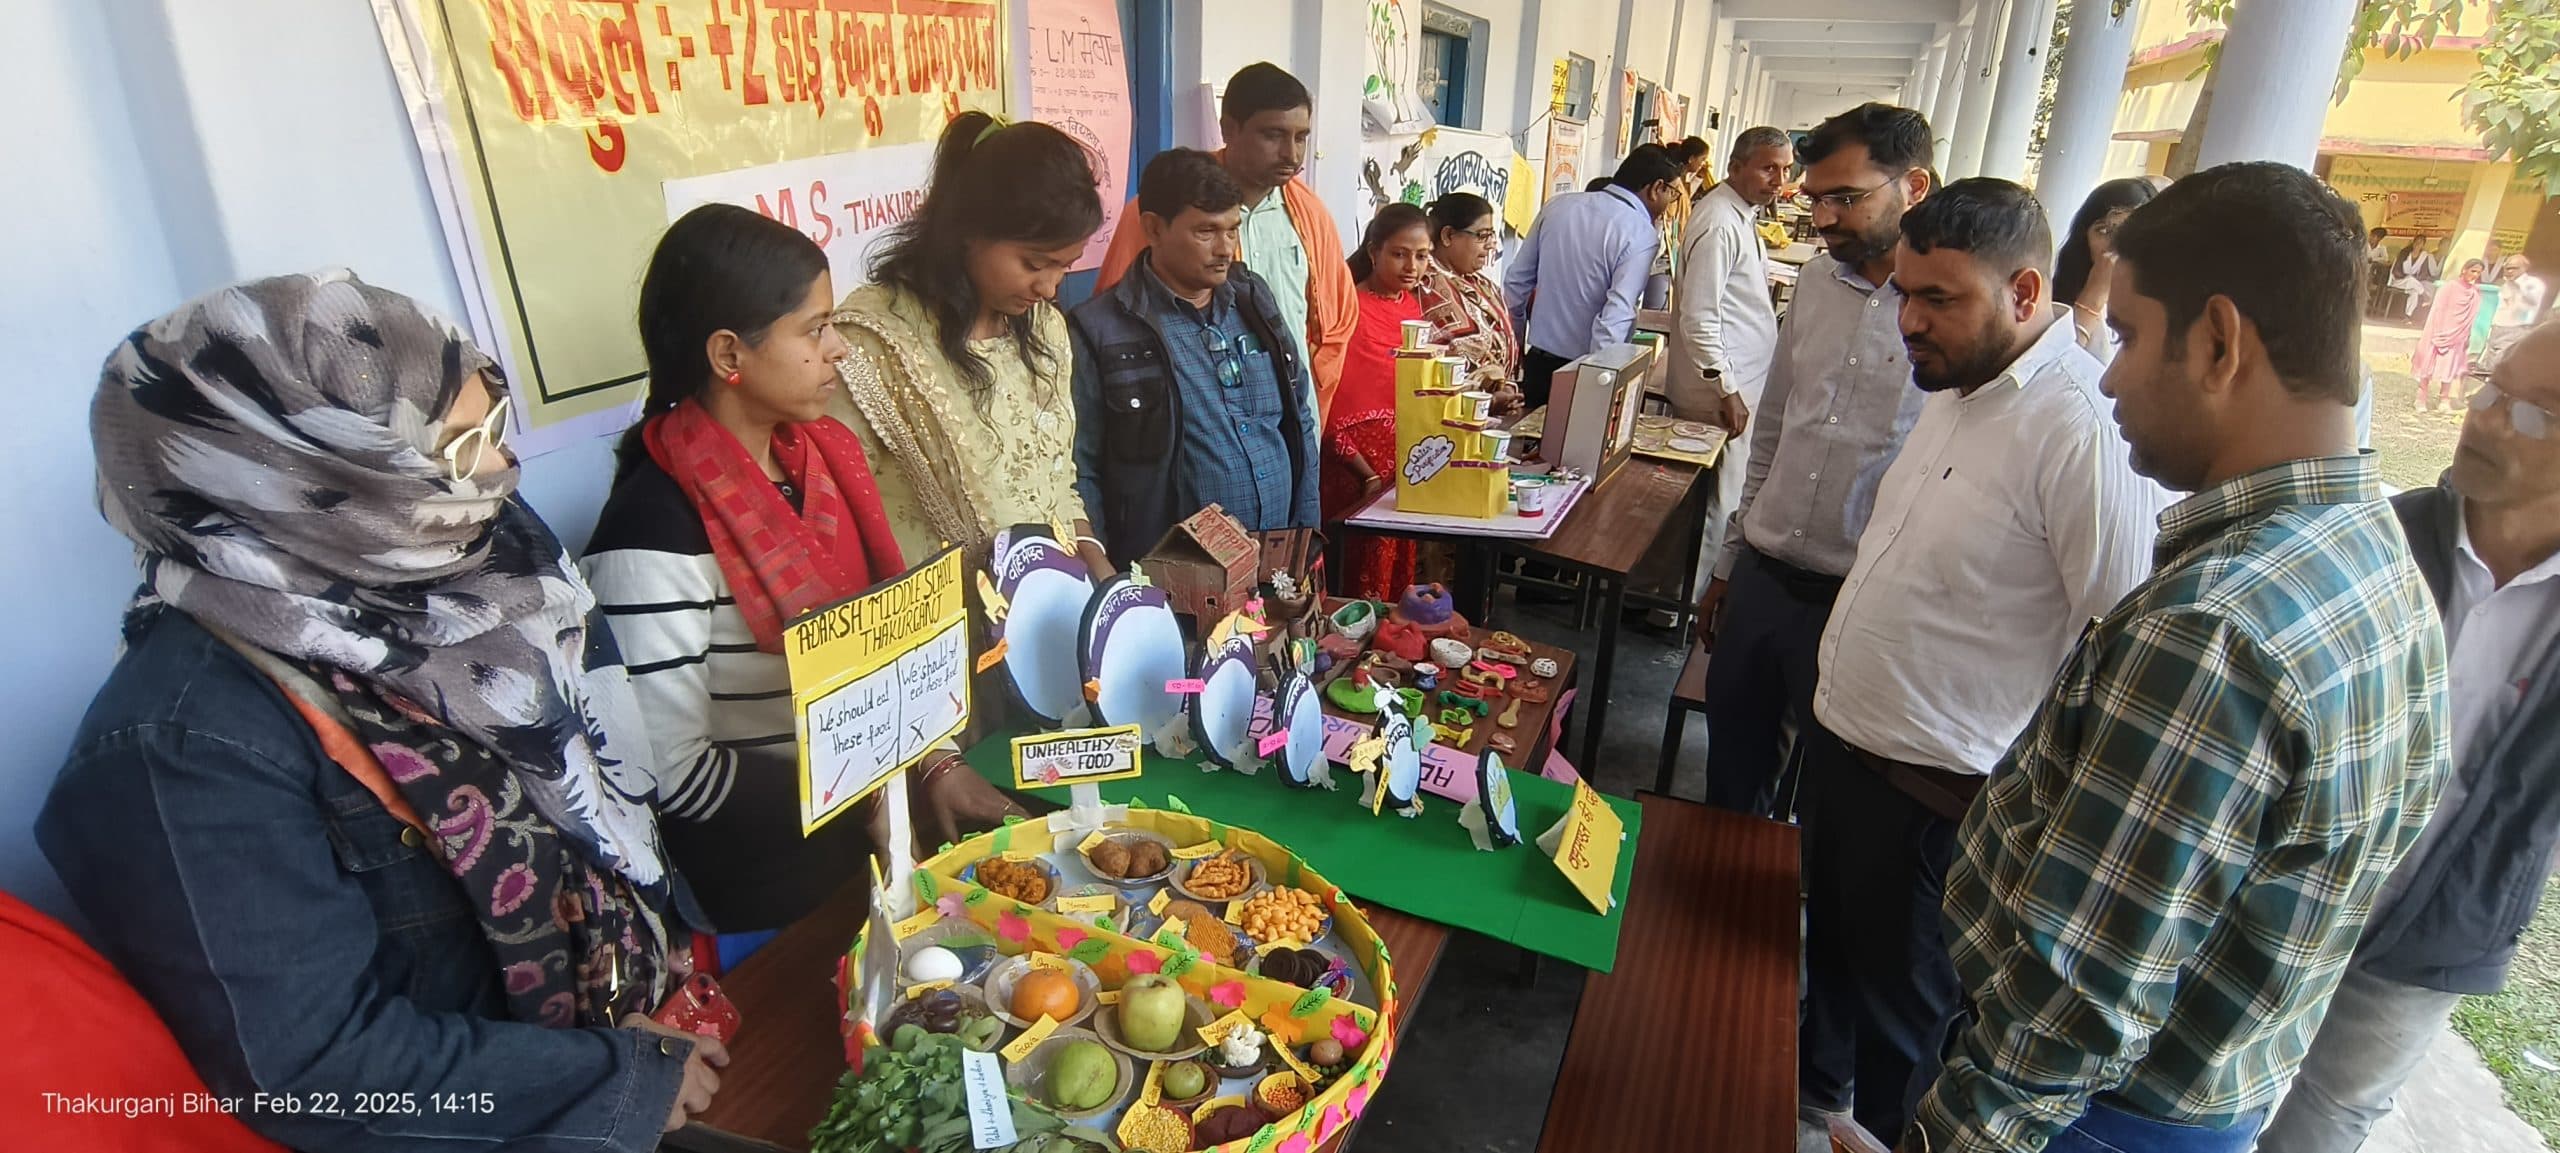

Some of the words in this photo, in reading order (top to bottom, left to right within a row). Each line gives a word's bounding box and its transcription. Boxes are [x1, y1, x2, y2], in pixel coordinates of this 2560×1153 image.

[796, 601, 863, 656] ADARSH
[867, 571, 921, 626] MIDDLE
[860, 593, 943, 657] THAKURGANJ
[819, 706, 834, 734] We
[836, 686, 875, 728] should
[876, 679, 890, 708] eat
[832, 731, 864, 757] these
[866, 711, 892, 748] food
[1026, 738, 1117, 760] UNHEALTHY
[1077, 752, 1115, 771] FOOD
